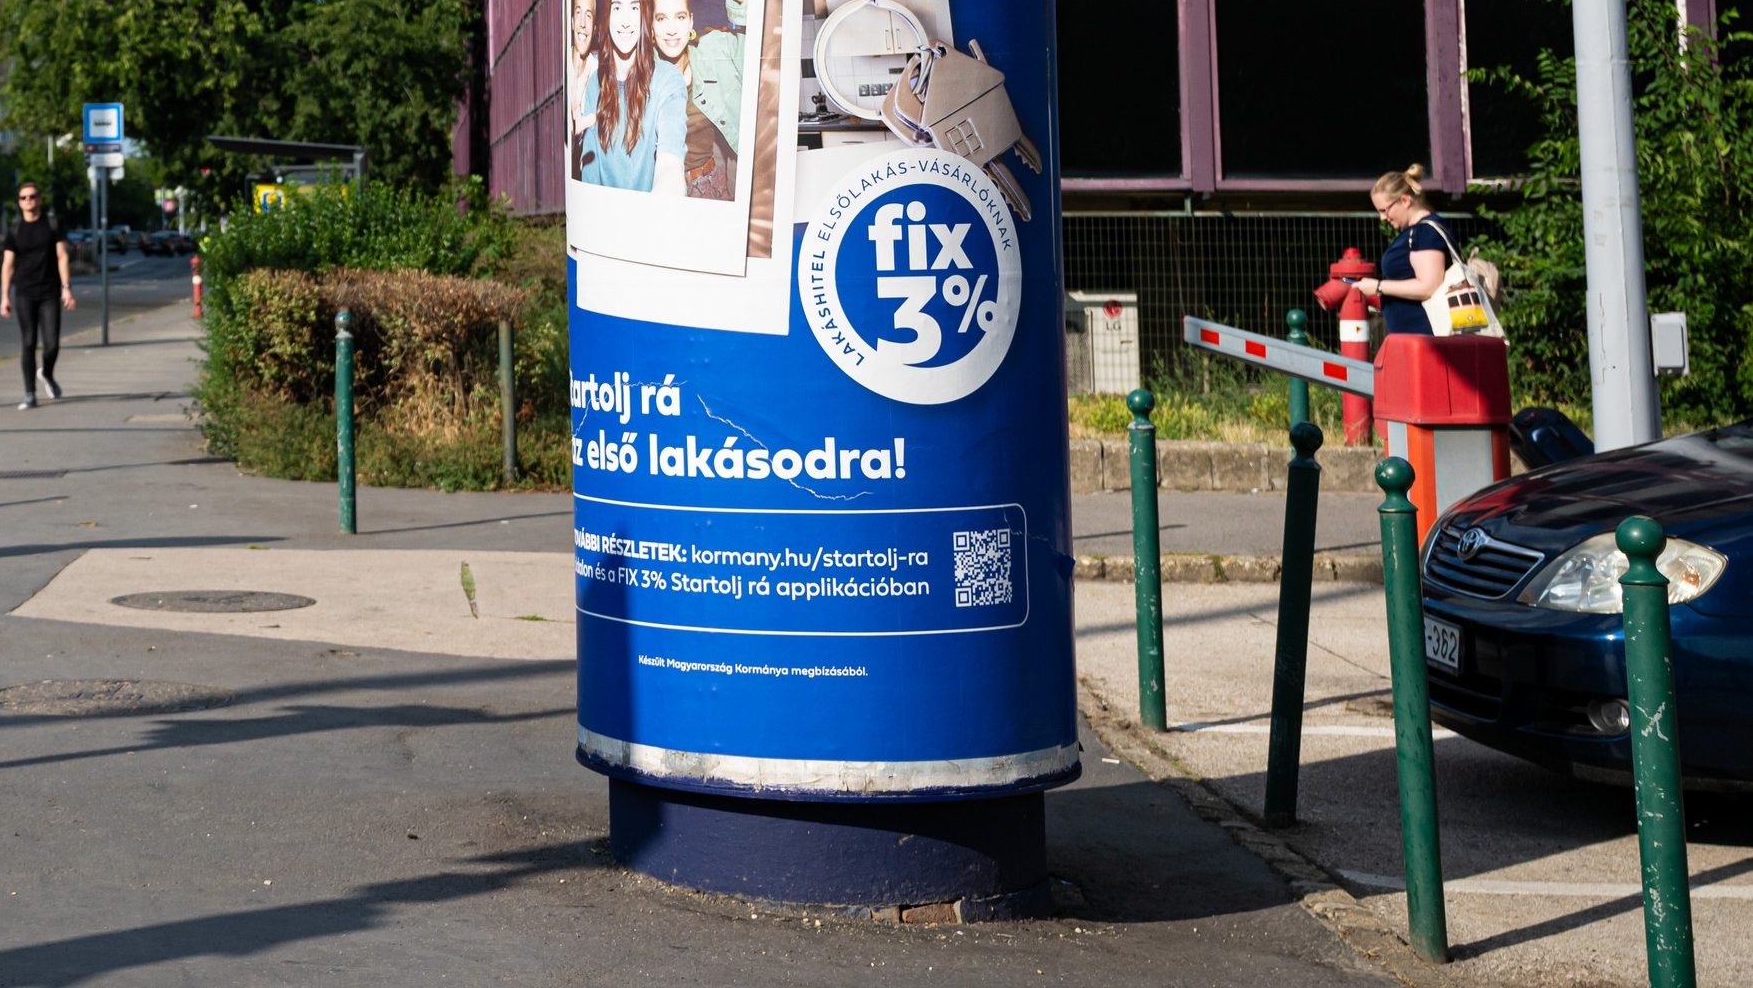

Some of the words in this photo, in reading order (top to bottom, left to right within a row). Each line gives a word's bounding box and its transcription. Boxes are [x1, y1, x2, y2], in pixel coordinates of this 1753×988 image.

[817, 158, 1012, 251] ELSŐLAKÁS-VÁSÁRLÓKNAK
[868, 200, 974, 271] fix
[811, 250, 865, 366] LAKÁSHITEL
[876, 274, 999, 365] 3%
[570, 368, 631, 425] tartolj
[641, 373, 681, 416] rá
[587, 429, 638, 474] első
[649, 433, 907, 481] lakásodra!
[602, 533, 687, 562] RÉSZLETEK:
[692, 545, 928, 572] kormany.hu/startolj-ra
[595, 562, 606, 581] és
[608, 572, 616, 583] a
[618, 567, 639, 587] FIX
[641, 570, 667, 590] 3%
[671, 572, 742, 600] Startolj
[748, 576, 770, 596] rá
[776, 576, 930, 601] applikációban
[638, 655, 665, 668] Készült
[667, 658, 733, 675] Magyarország
[735, 663, 789, 678] Kormánya
[791, 666, 869, 679] megbízásából.
